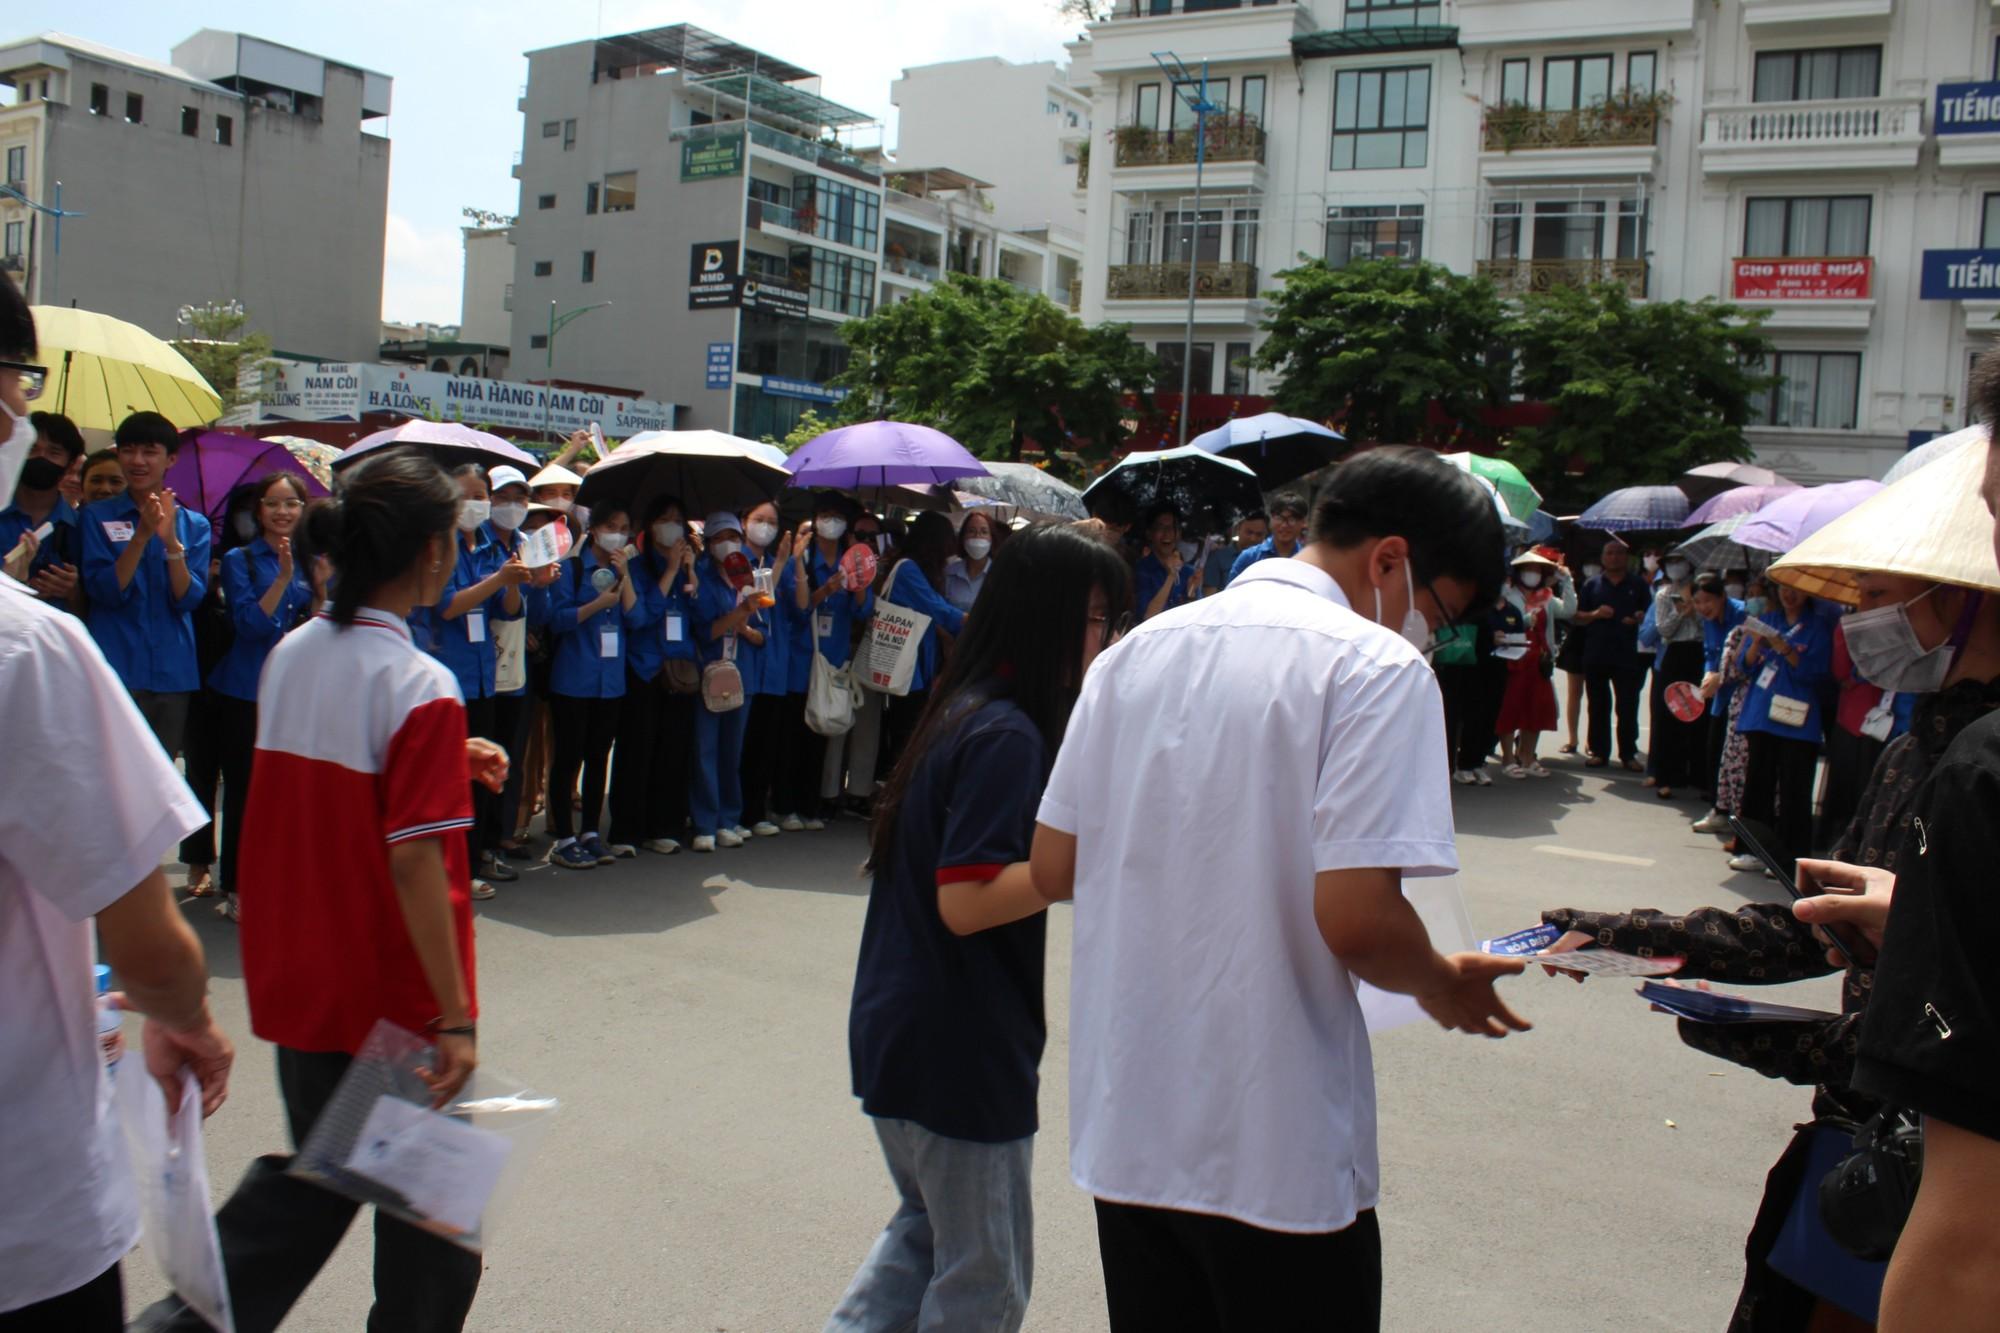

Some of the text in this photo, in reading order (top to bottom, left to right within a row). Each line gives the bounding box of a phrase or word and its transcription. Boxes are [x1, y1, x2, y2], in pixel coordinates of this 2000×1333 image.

[700, 272, 726, 283] NMD
[1738, 264, 1774, 277] CHO
[305, 375, 358, 390] NAM CÒI
[390, 381, 411, 393] BIA
[446, 379, 484, 401] NHÀ
[488, 382, 535, 407] HÀNG
[538, 391, 575, 412] NAM
[578, 396, 604, 416] CÒI
[616, 414, 668, 430] SAPPHIRE
[872, 618, 911, 638] IETNAM
[882, 613, 914, 629] JAPAN
